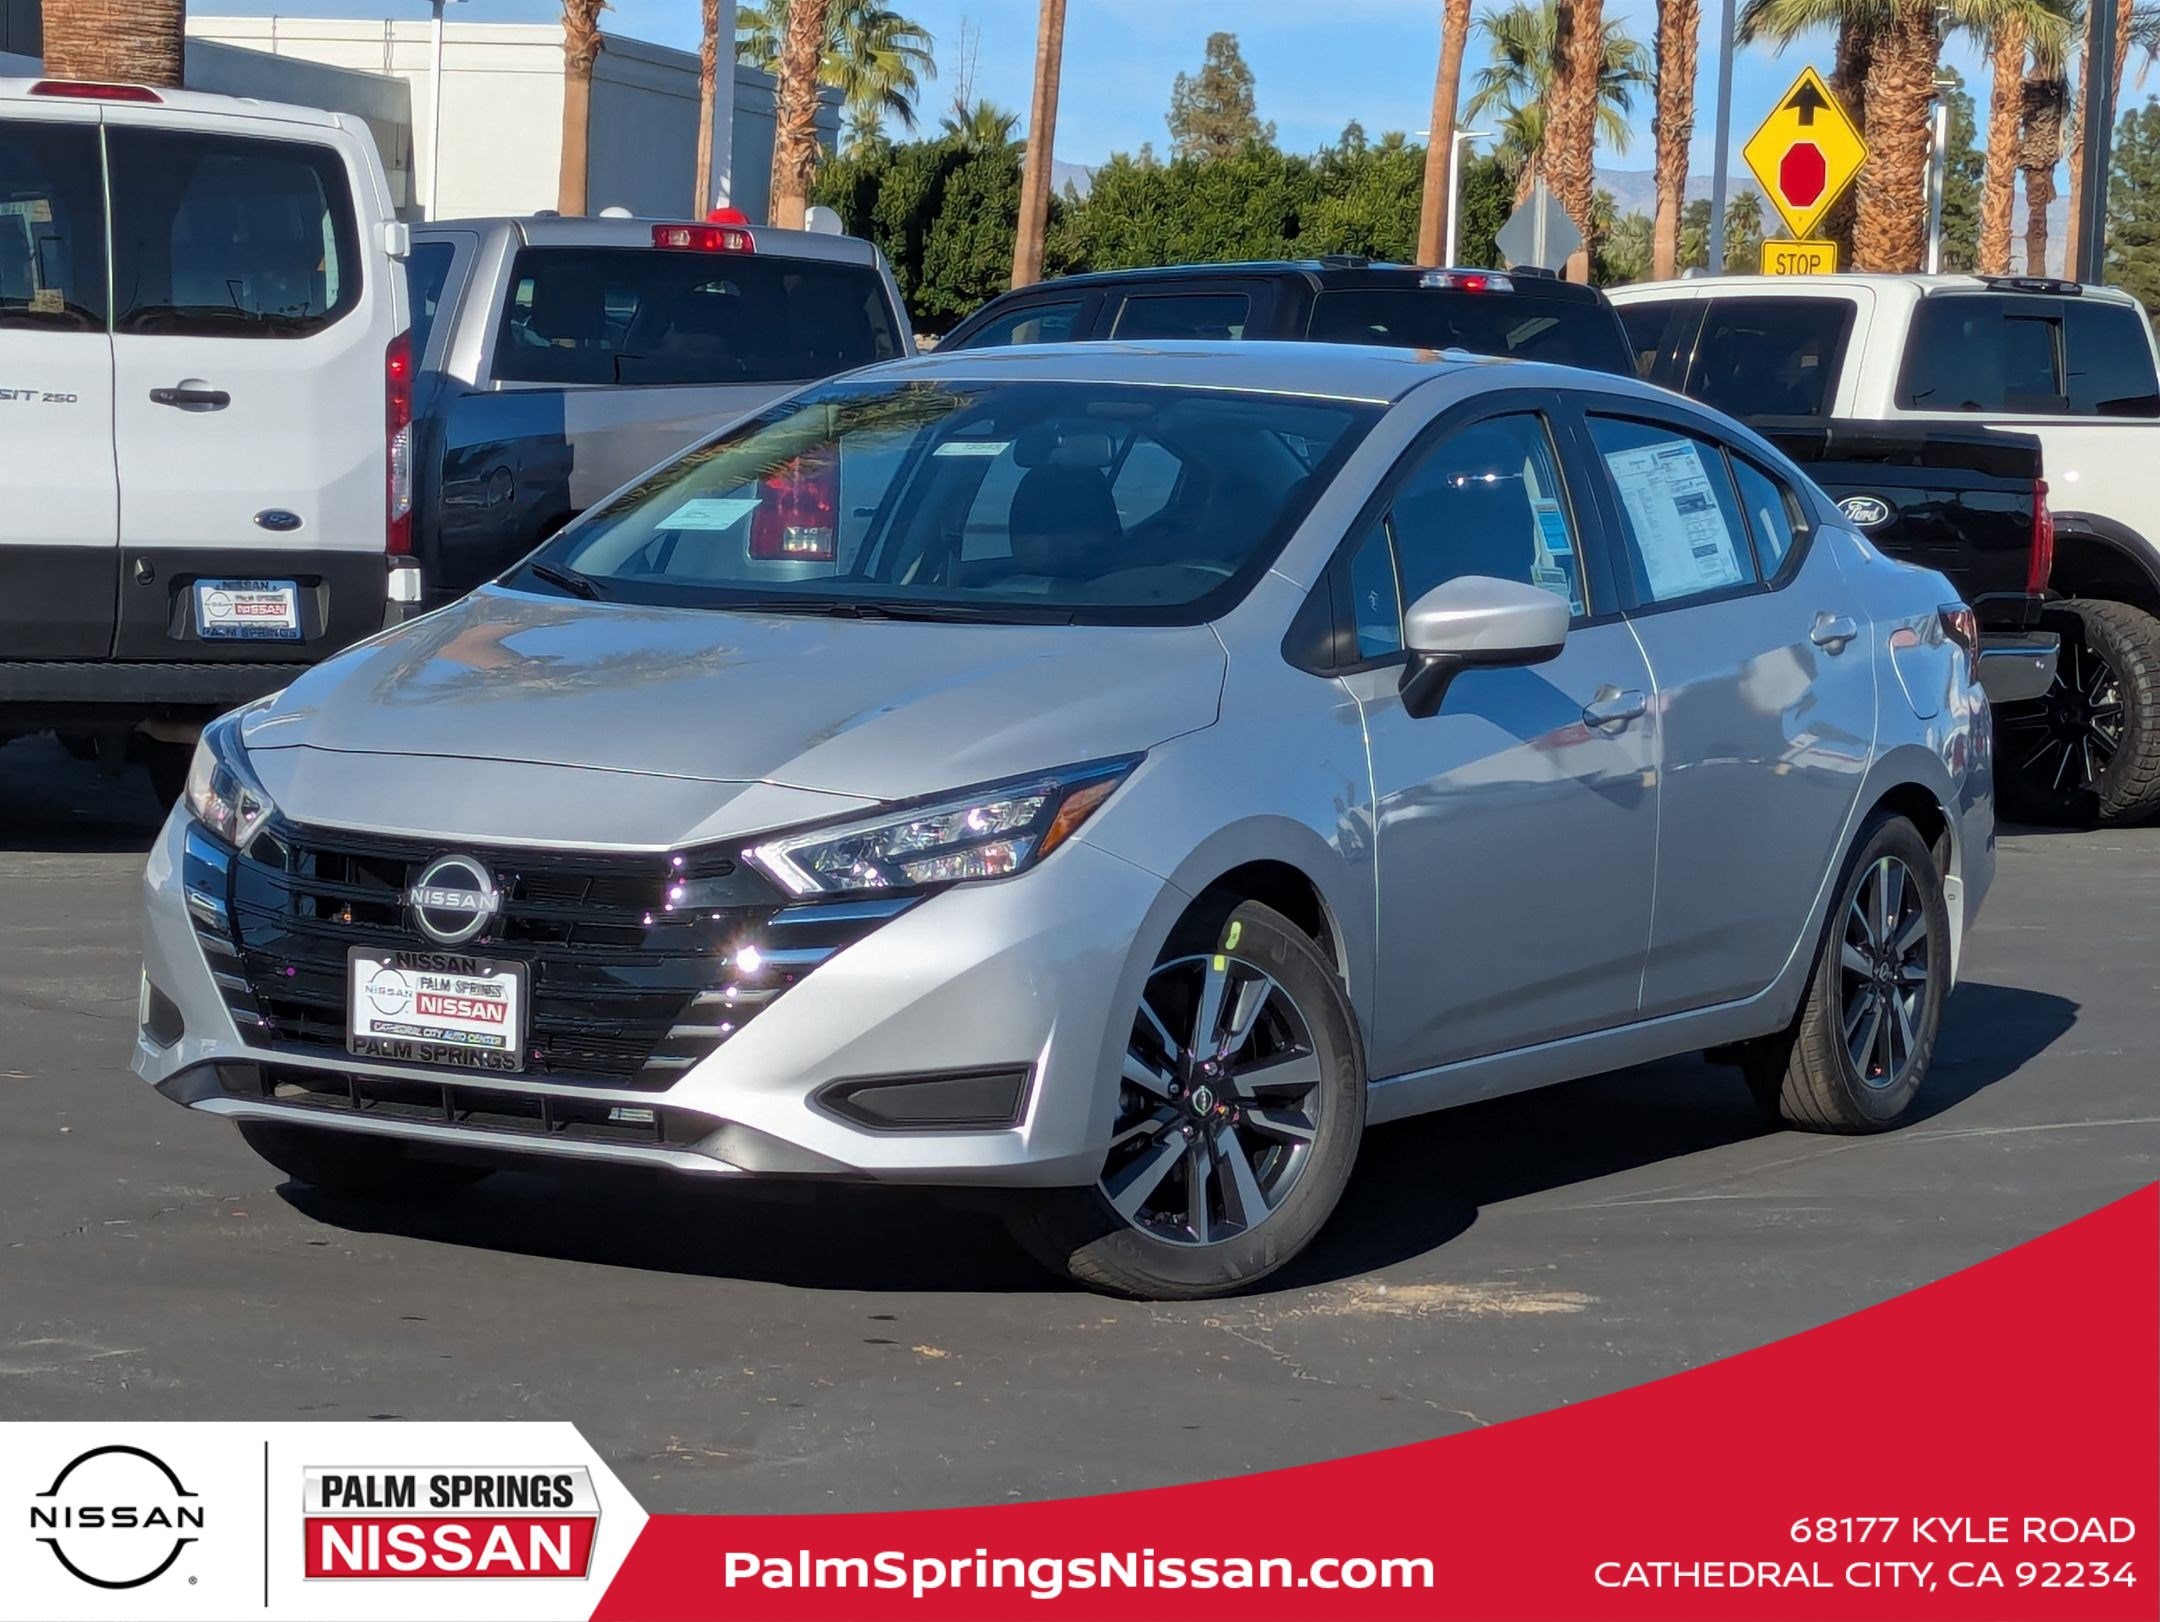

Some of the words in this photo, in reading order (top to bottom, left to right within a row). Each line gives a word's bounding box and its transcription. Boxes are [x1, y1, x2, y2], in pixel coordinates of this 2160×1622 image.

[1776, 253, 1821, 275] STOP
[42, 392, 78, 403] 250
[1844, 500, 1881, 521] Ford
[236, 605, 285, 615] NISSAN
[410, 888, 497, 911] NISSAN
[395, 952, 477, 974] NISSAN
[365, 984, 413, 998] NISSAN
[420, 976, 451, 993] PALM
[455, 979, 502, 998] SPRINGS
[420, 997, 504, 1022] NISSAN
[353, 1036, 412, 1060] PALM
[419, 1042, 517, 1070] SPRINGS
